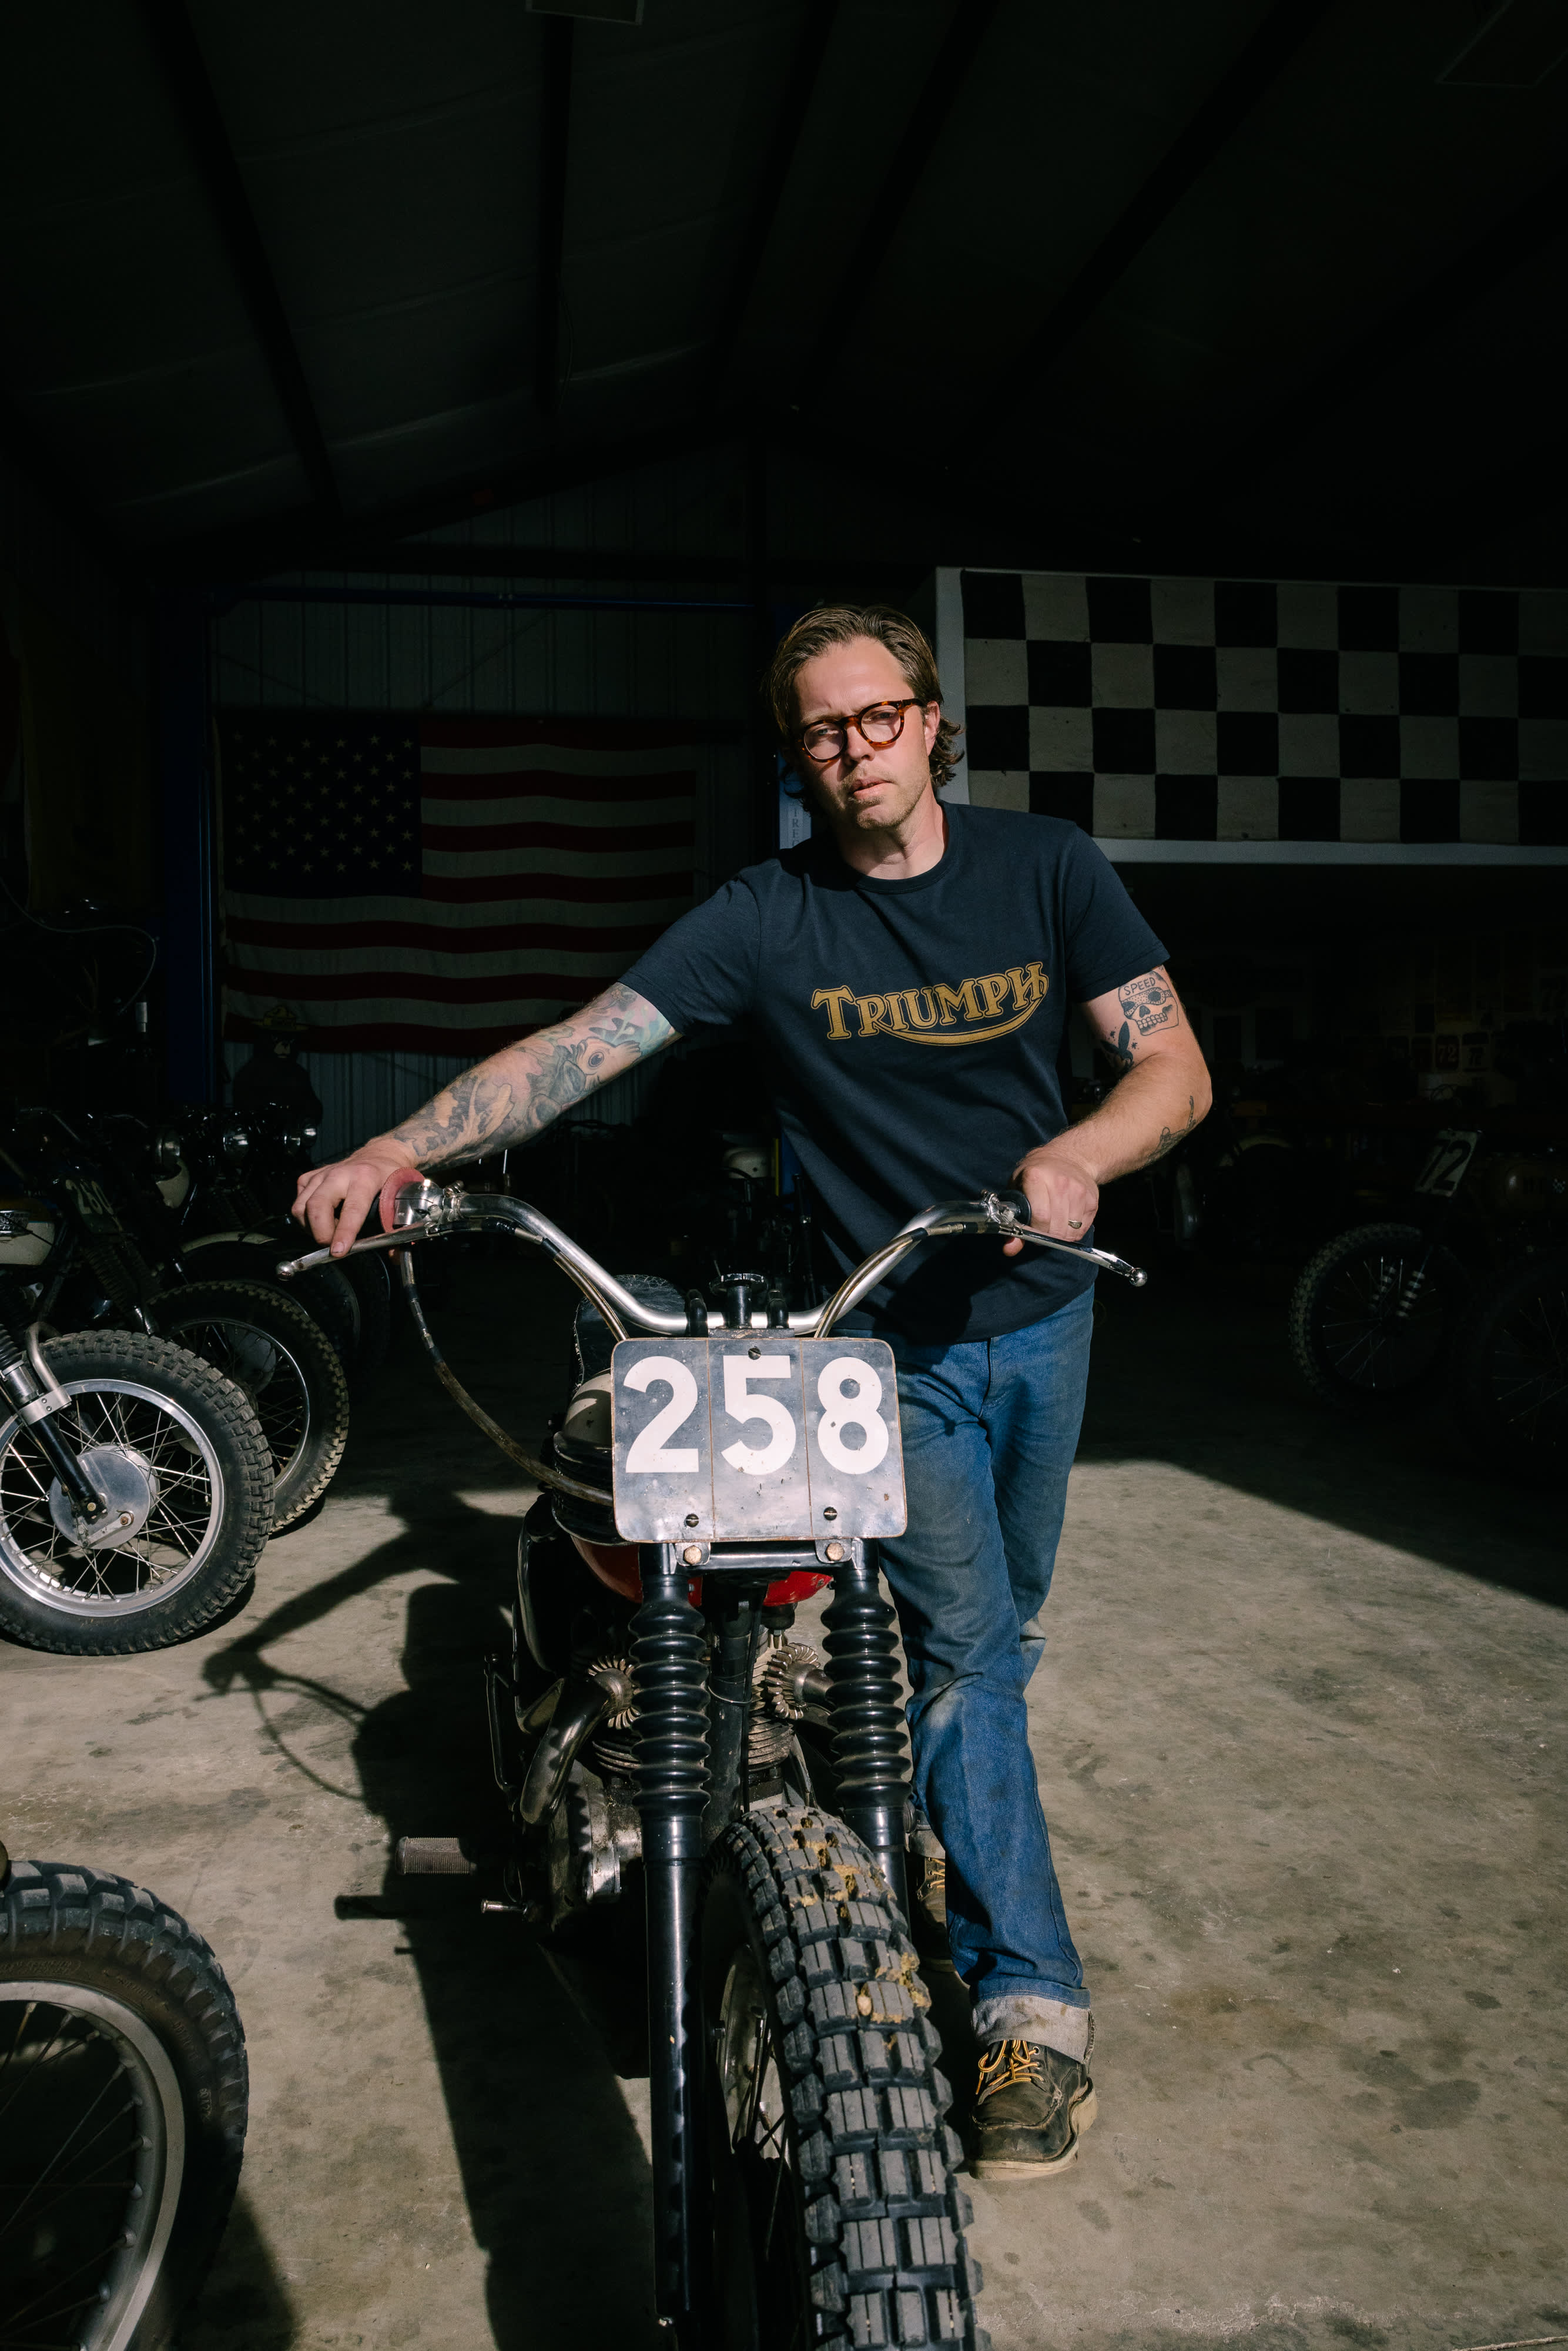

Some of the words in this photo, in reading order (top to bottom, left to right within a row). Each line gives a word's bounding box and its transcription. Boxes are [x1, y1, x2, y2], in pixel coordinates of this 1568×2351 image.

[811, 961, 1048, 1046] TRIUMPH
[1124, 977, 1156, 996] SPEED
[623, 1355, 889, 1475] 258
